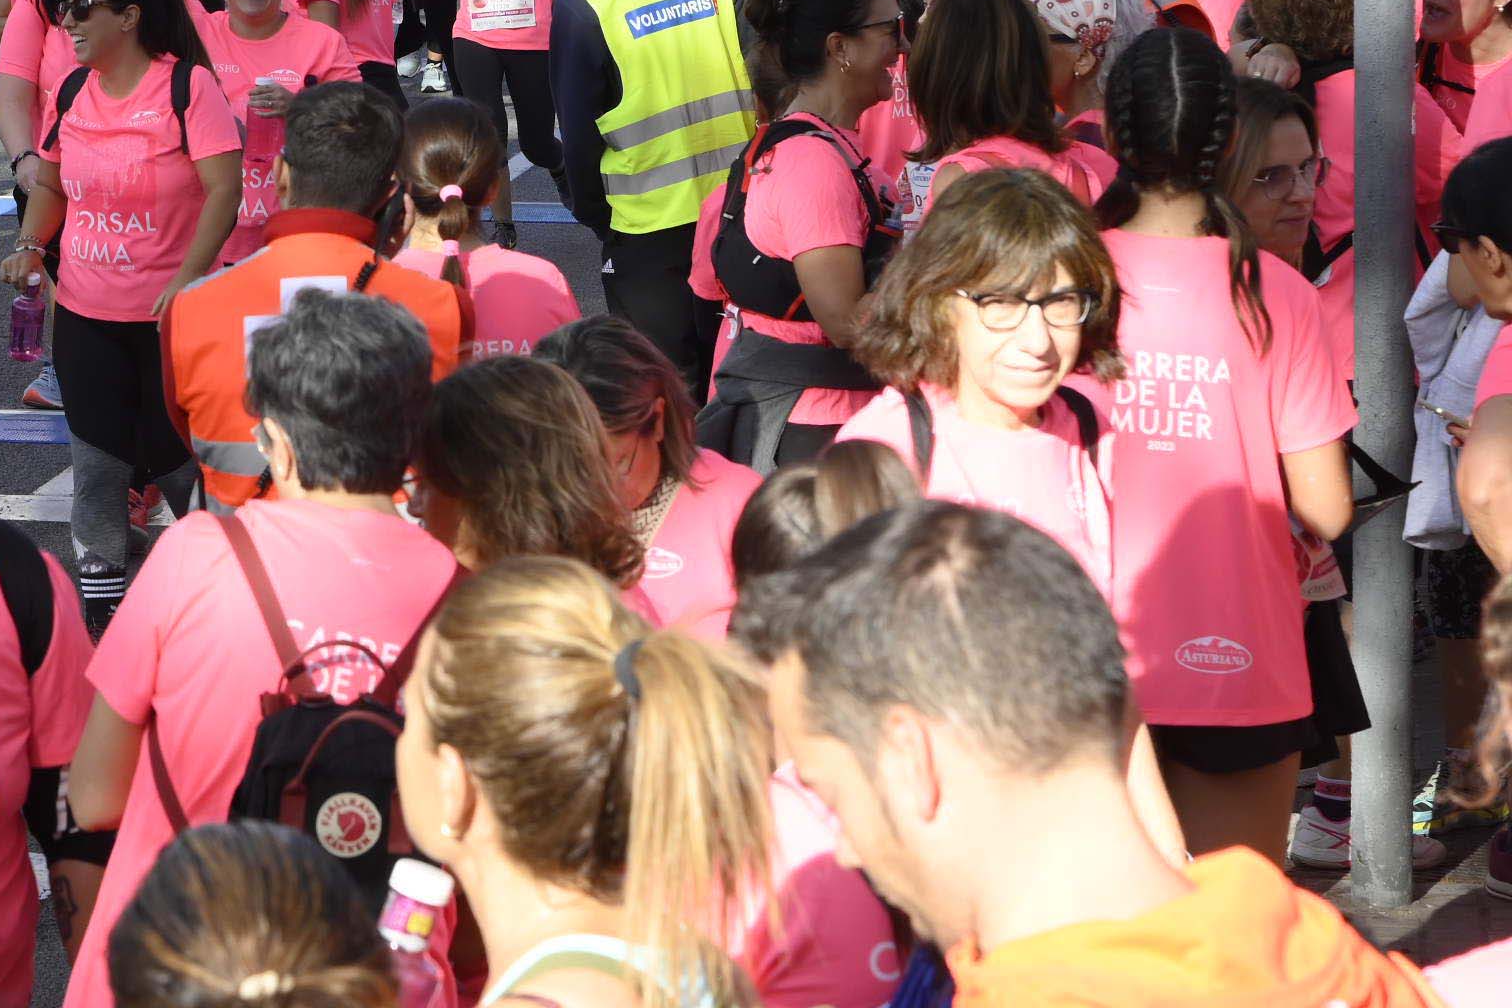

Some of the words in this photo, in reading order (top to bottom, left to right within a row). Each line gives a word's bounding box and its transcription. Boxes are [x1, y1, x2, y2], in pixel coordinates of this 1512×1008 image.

[63, 179, 82, 201] TU
[71, 236, 132, 264] SUMA
[1115, 380, 1156, 407] DE
[1169, 382, 1208, 411] LA
[1110, 410, 1213, 441] MUJER
[1181, 649, 1248, 668] ASTURIANA
